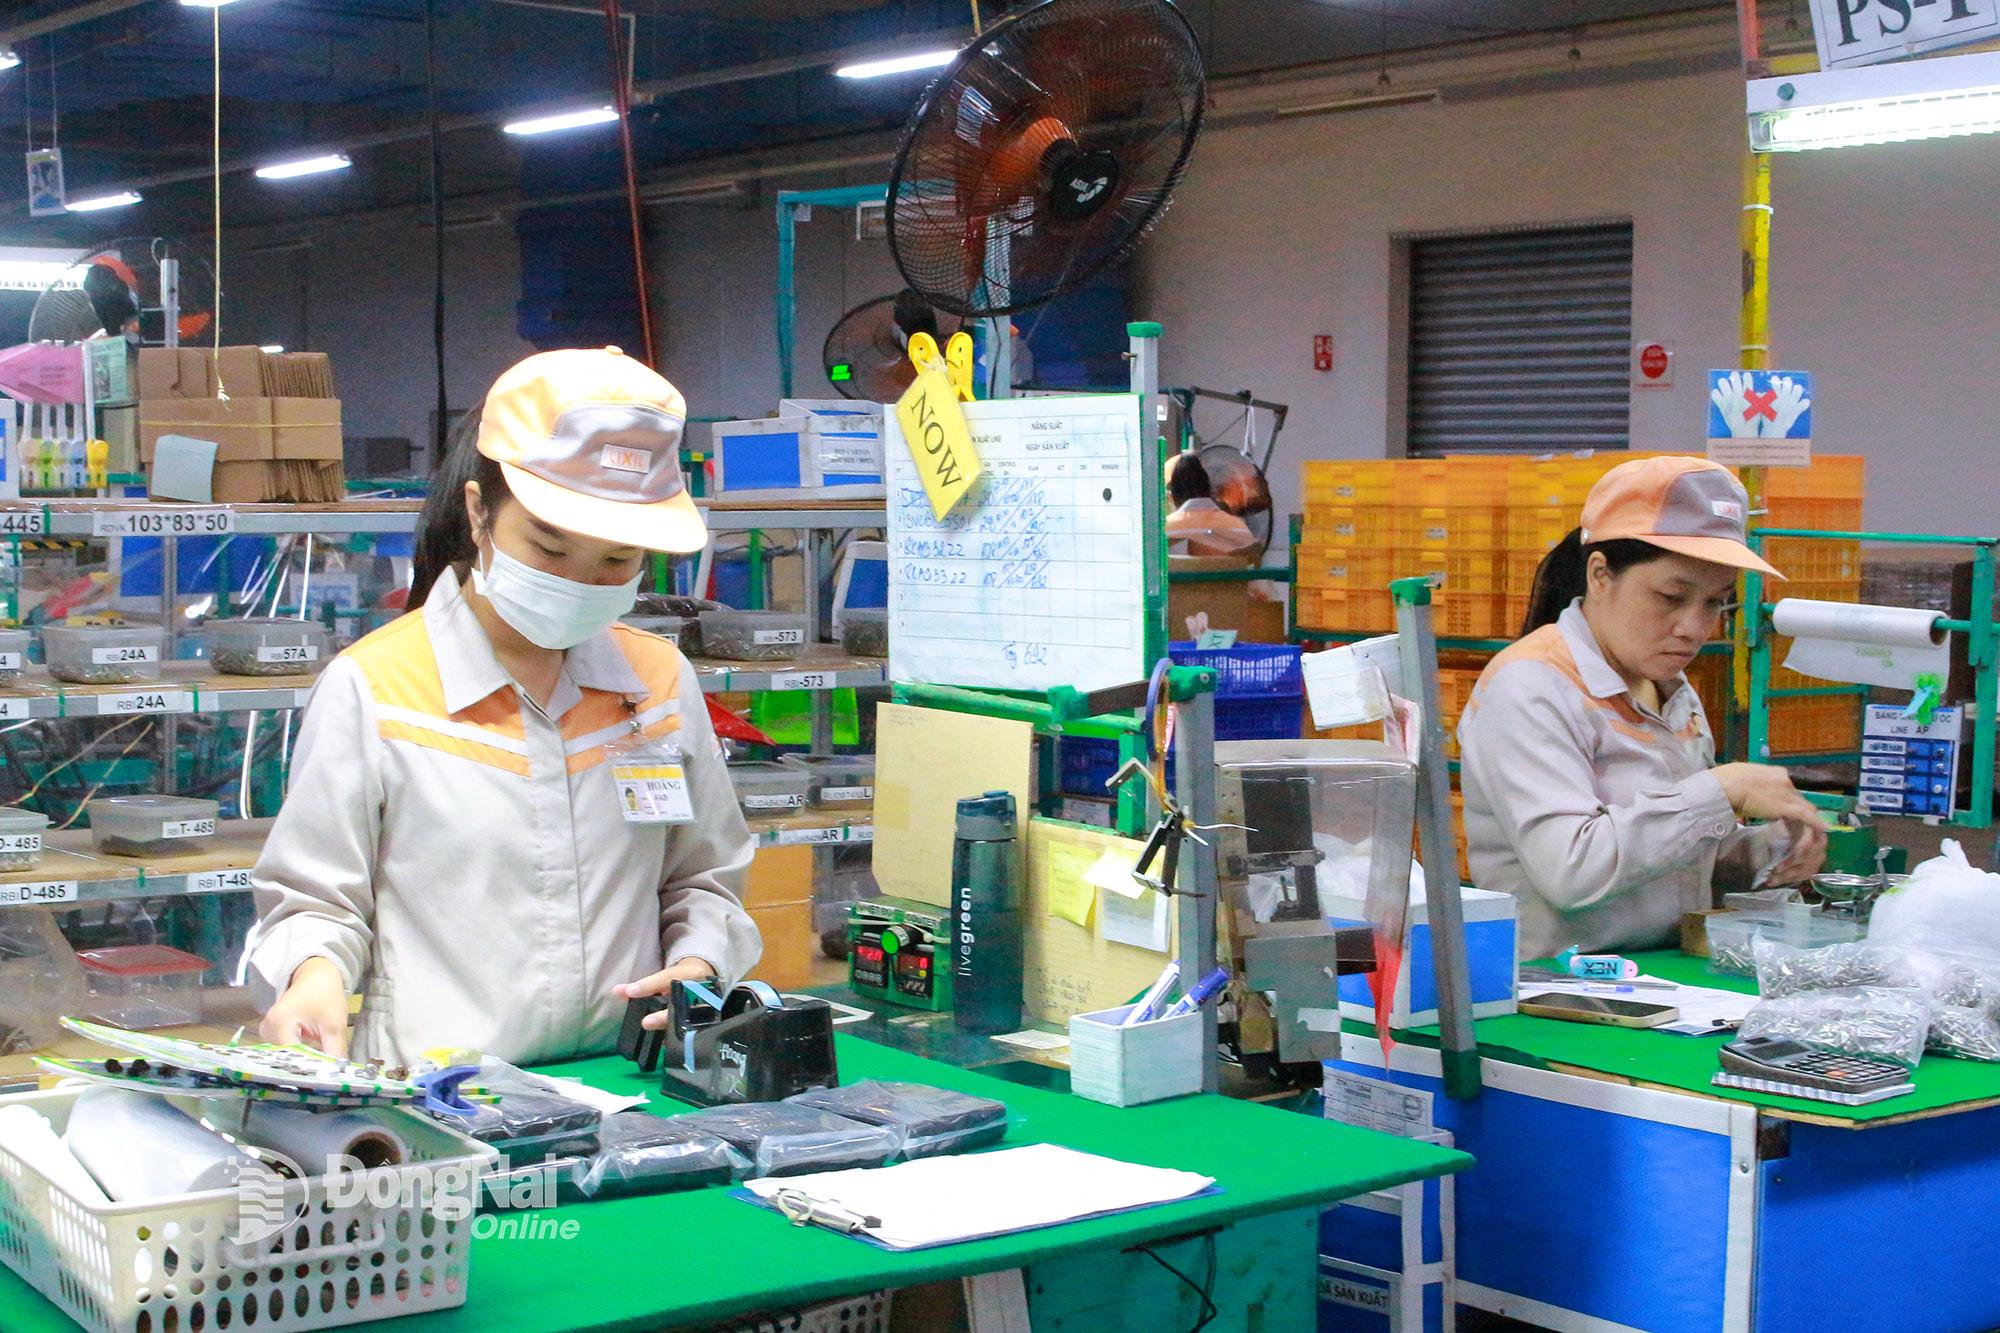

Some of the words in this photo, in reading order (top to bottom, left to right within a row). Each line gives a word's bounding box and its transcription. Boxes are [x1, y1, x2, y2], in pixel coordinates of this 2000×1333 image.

[910, 395, 962, 488] NOW
[136, 695, 166, 709] 24A
[20, 884, 66, 900] D-485
[958, 887, 975, 977] livegreen
